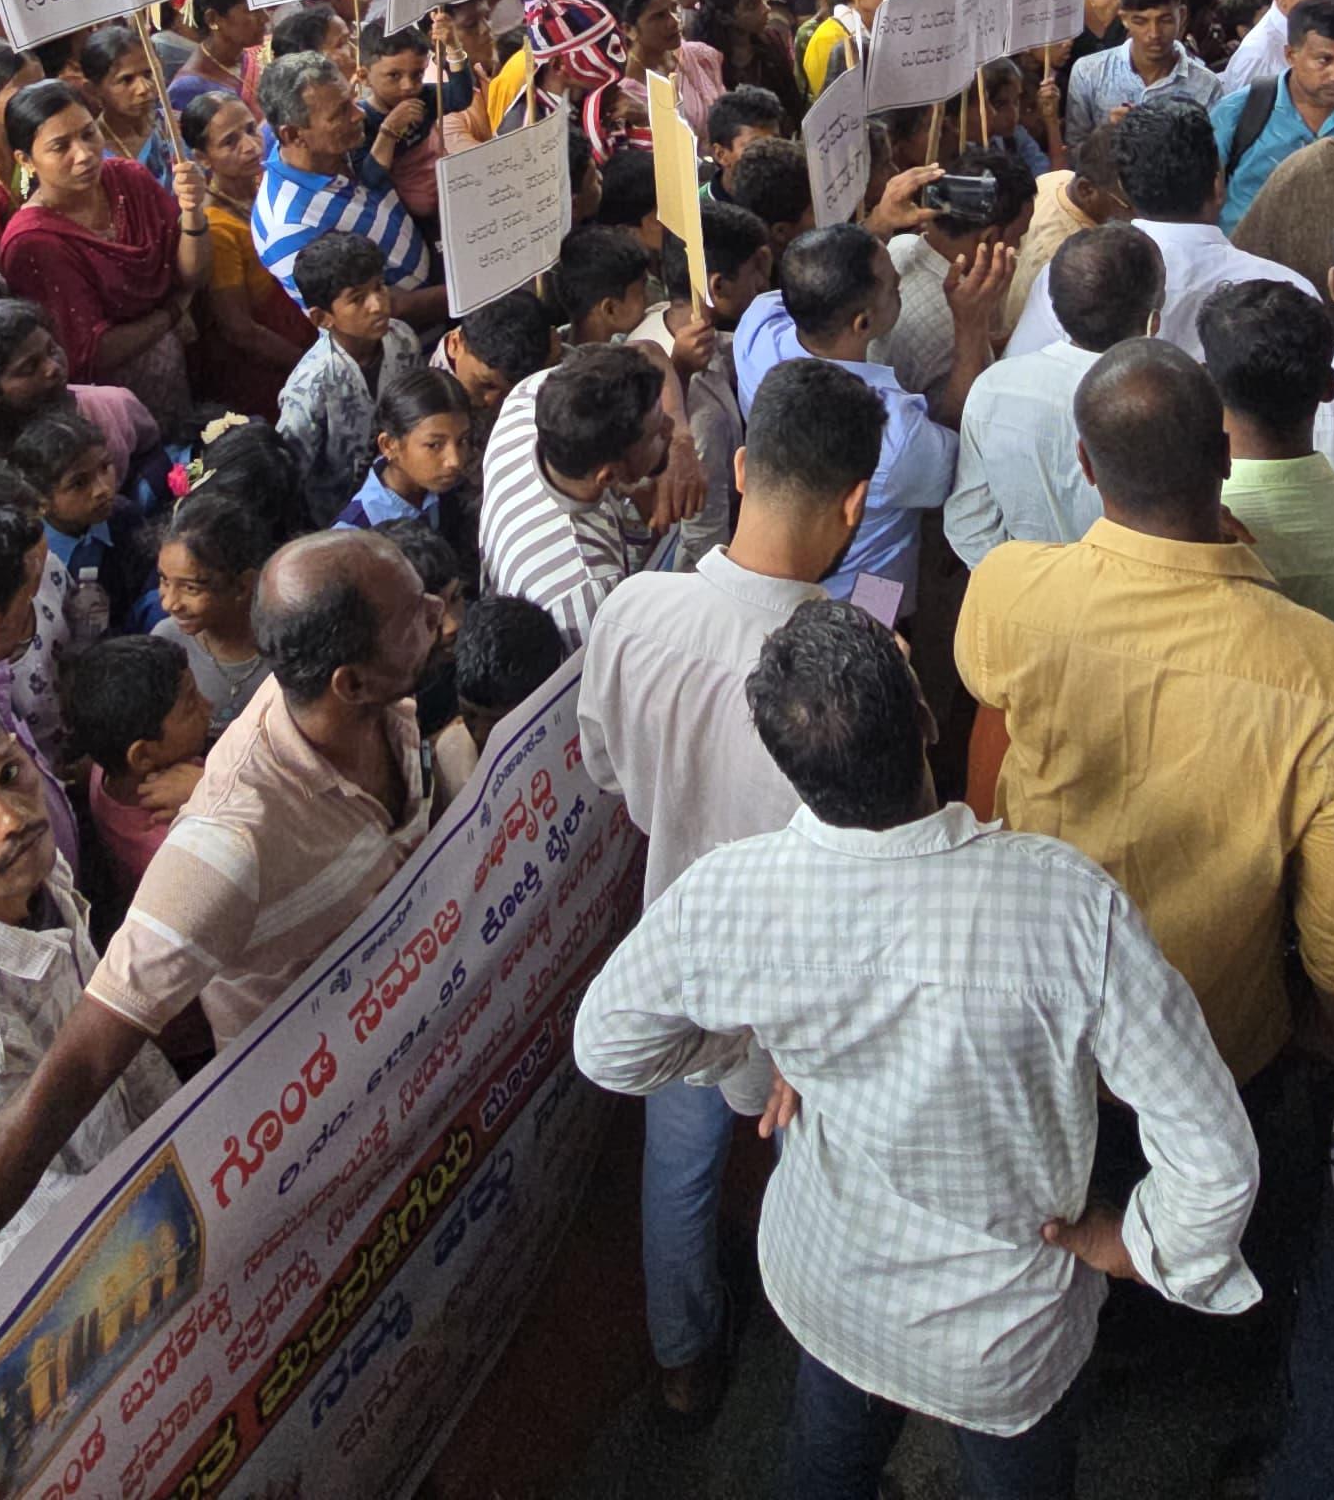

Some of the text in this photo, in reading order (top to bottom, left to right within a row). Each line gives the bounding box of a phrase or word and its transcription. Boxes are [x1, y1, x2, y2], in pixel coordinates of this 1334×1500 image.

[491, 724, 547, 798] ಮಹಾಸತಿ
[210, 1032, 338, 1209] ಗೊಂಡ
[348, 899, 462, 1044] ಸಮಾಜ
[473, 767, 558, 894] ಅಭಿವೃದ್ಧಿ
[328, 967, 353, 997] ಜೈ
[479, 859, 543, 947] ಕೋಕ್ತಿ
[120, 1282, 233, 1424] ಬುಡಕಟ್ಟು
[244, 1105, 391, 1283] ಸಮುದಾಯಕ್ಕೆ
[557, 835, 605, 902] ಪಂಗಡ
[257, 1125, 474, 1422] ಮೆರವಣಿಗೆಯ
[481, 1020, 555, 1132] ಮೂಲಕ
[120, 1374, 213, 1500] ಪ್ರಮಾಣ
[225, 1250, 322, 1375] ಪತ್ರವನ್ನು
[311, 1292, 413, 1428] ನಮ್ಮ
[434, 1151, 515, 1267] ಹಕ್ಕು
